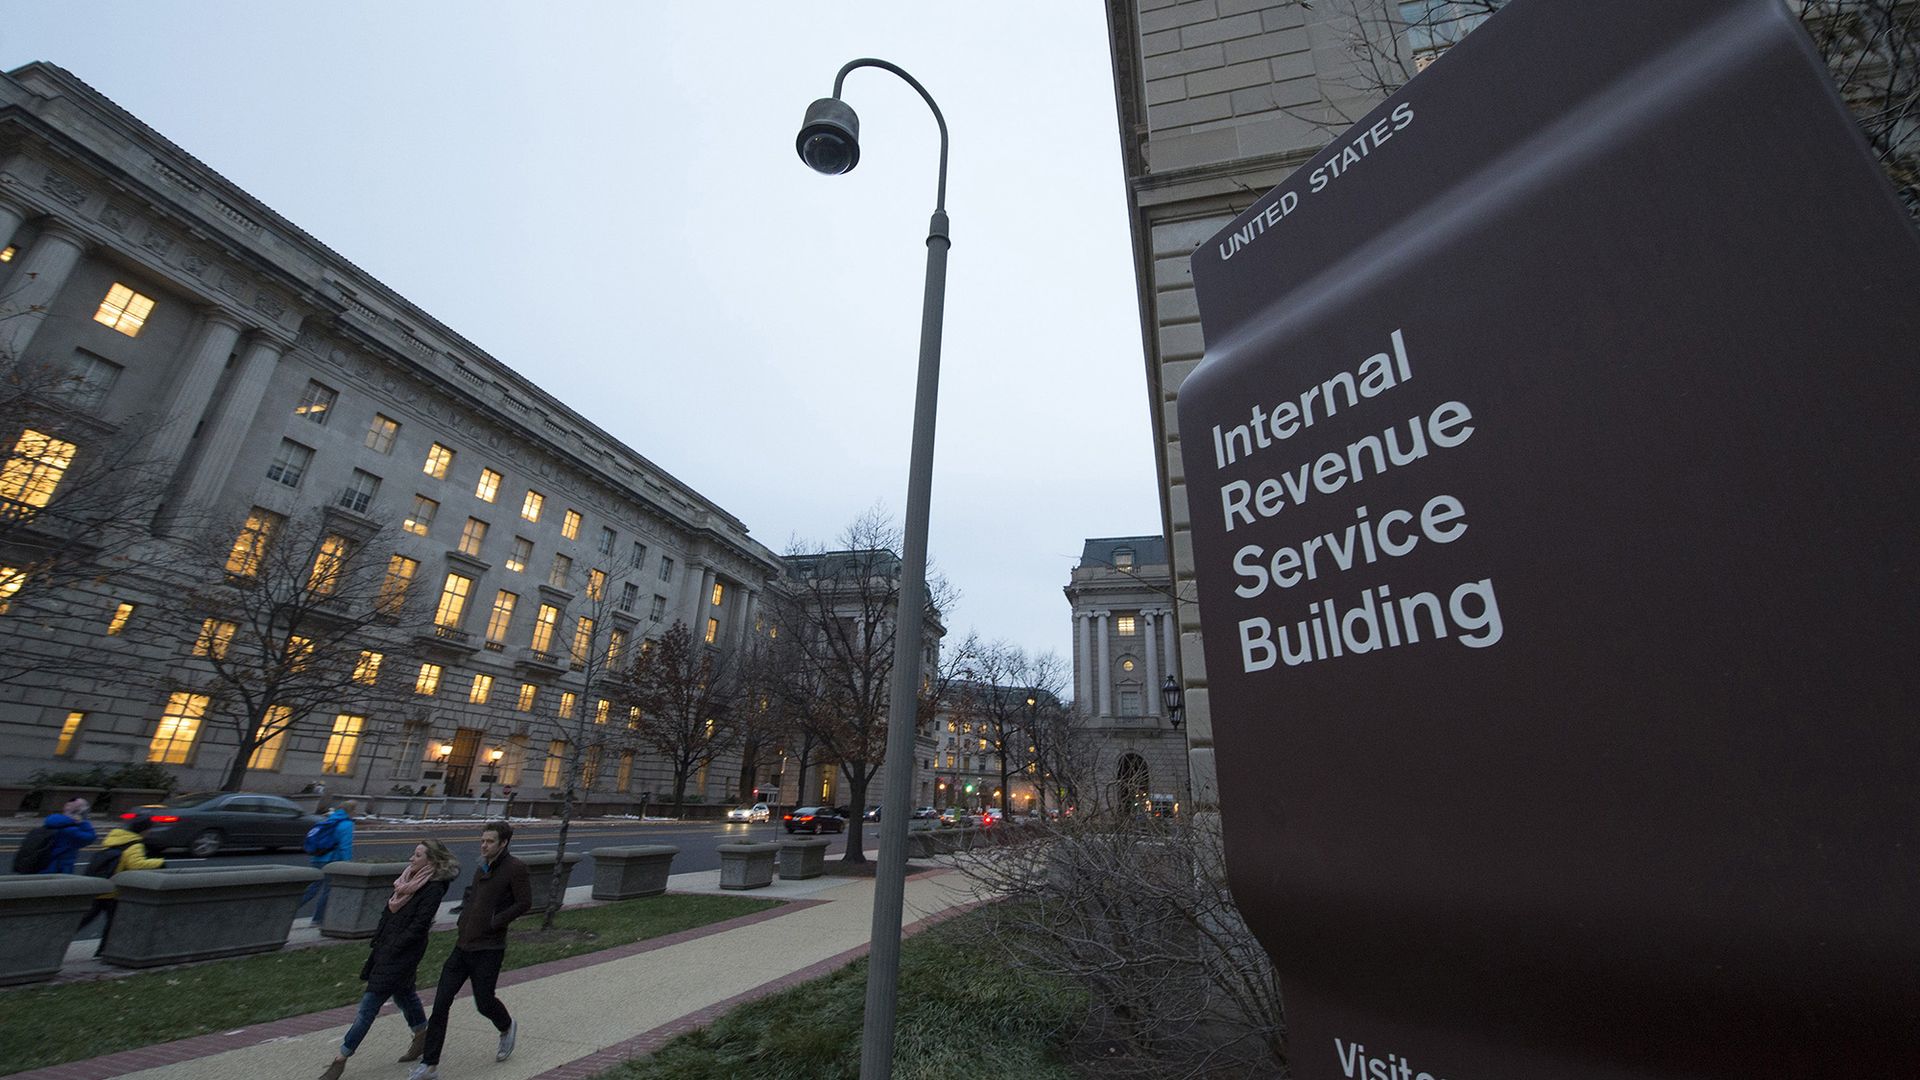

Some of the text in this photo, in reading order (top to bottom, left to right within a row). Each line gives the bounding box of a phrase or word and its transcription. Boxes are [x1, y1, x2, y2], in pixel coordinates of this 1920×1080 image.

[1219, 101, 1415, 262] UNITED STATES
[1212, 328, 1414, 470] Internal
[1220, 400, 1475, 532] Revenue
[1232, 494, 1468, 599] Service
[1238, 578, 1503, 673] Building
[1334, 1037, 1446, 1080] Visit
